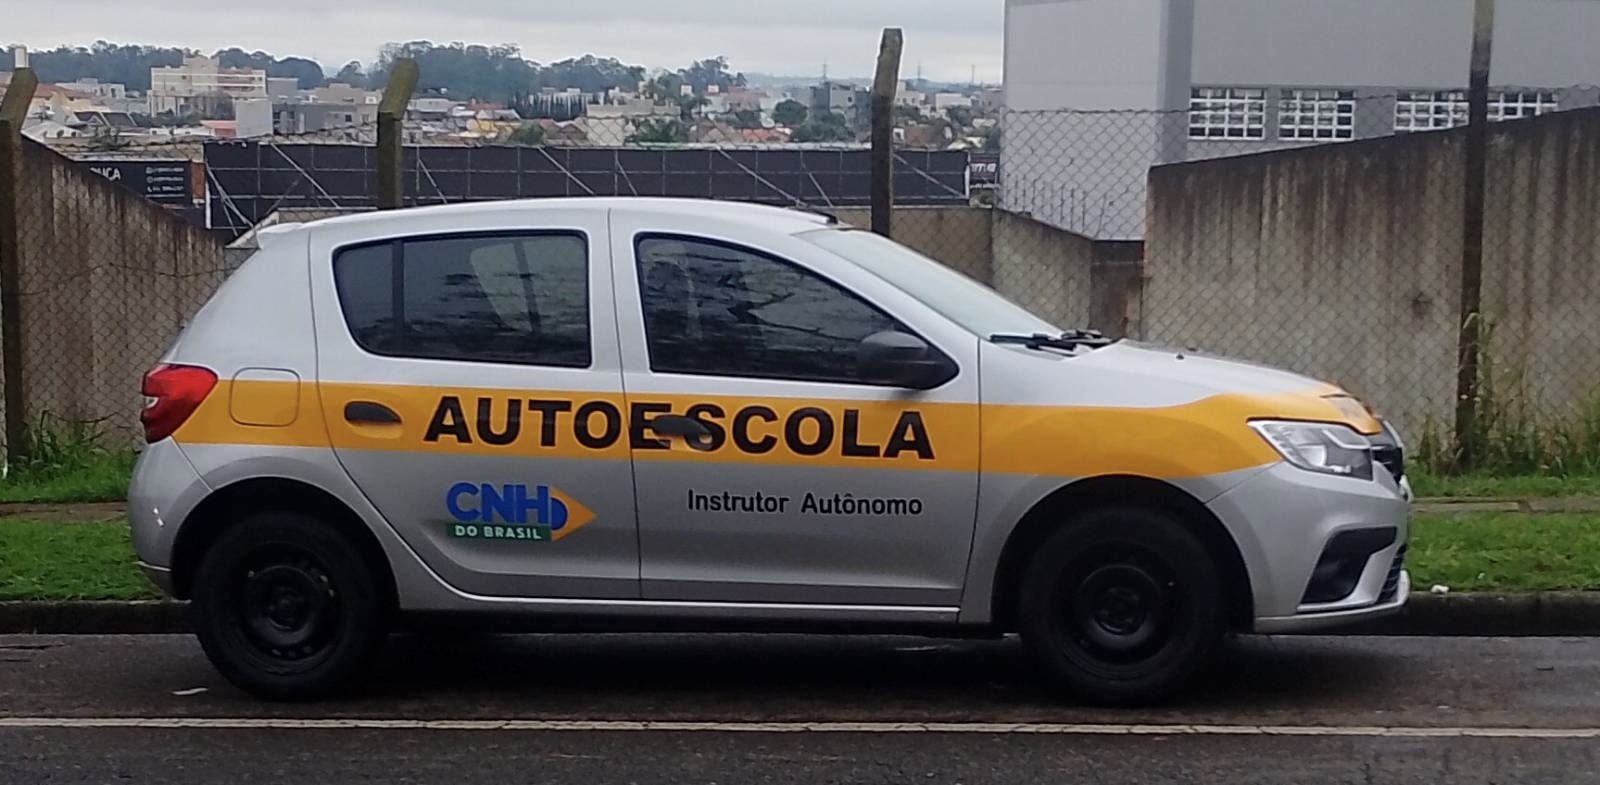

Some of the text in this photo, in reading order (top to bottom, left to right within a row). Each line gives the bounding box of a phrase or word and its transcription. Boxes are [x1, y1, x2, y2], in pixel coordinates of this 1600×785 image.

[423, 396, 936, 460] AUTOESCOLA
[446, 482, 549, 524] CNH
[688, 489, 923, 516] Instrutor Autônomo
[454, 525, 542, 540] DO BRASIL
